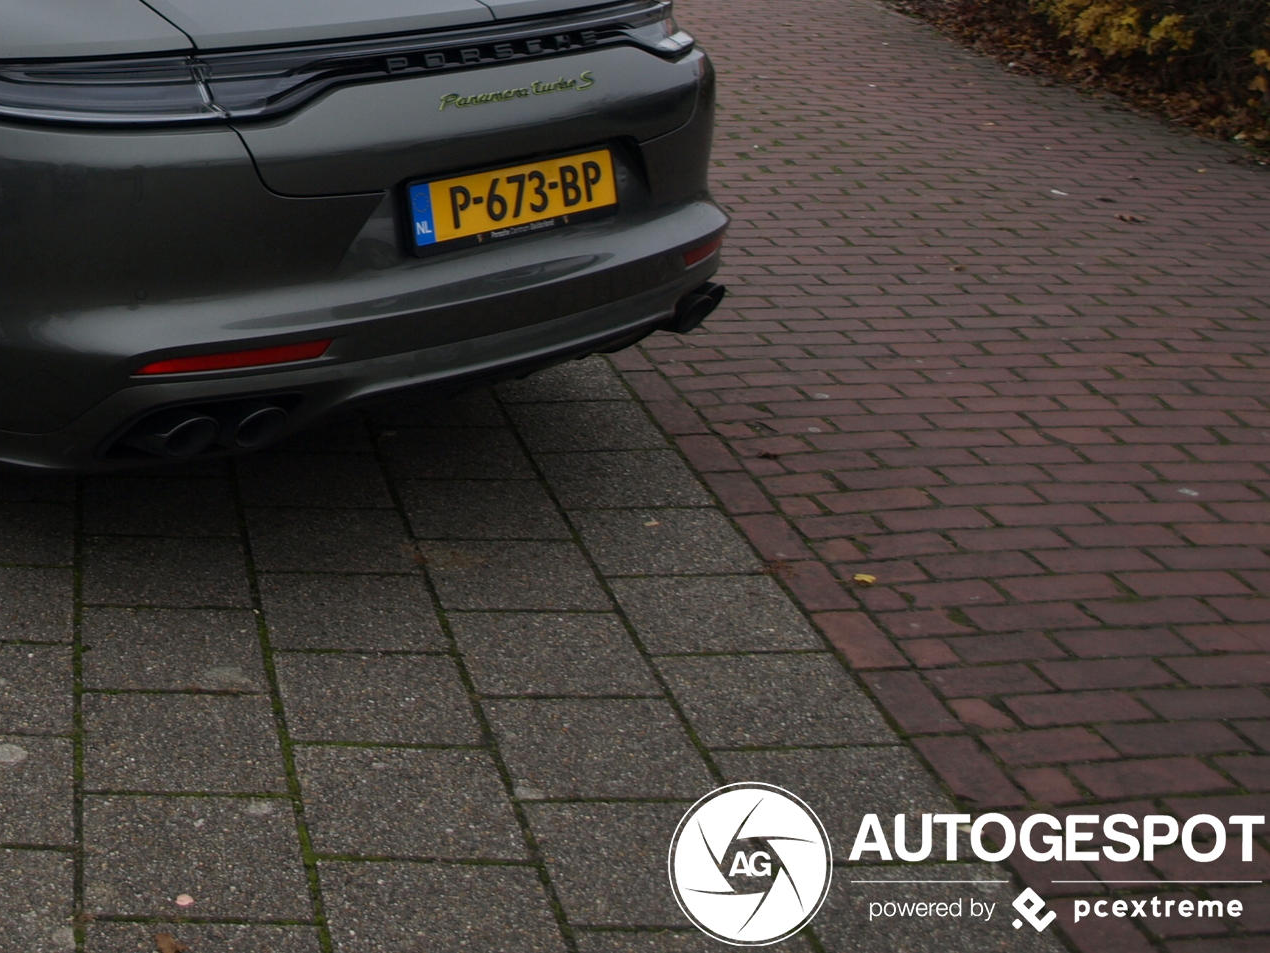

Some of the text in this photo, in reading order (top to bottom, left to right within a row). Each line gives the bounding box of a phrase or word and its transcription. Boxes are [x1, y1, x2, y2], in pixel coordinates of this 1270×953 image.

[387, 31, 597, 73] PORSCHE
[439, 88, 529, 111] Panamera
[576, 71, 596, 91] S
[449, 160, 602, 230] P-673-BP
[416, 220, 432, 235] NL
